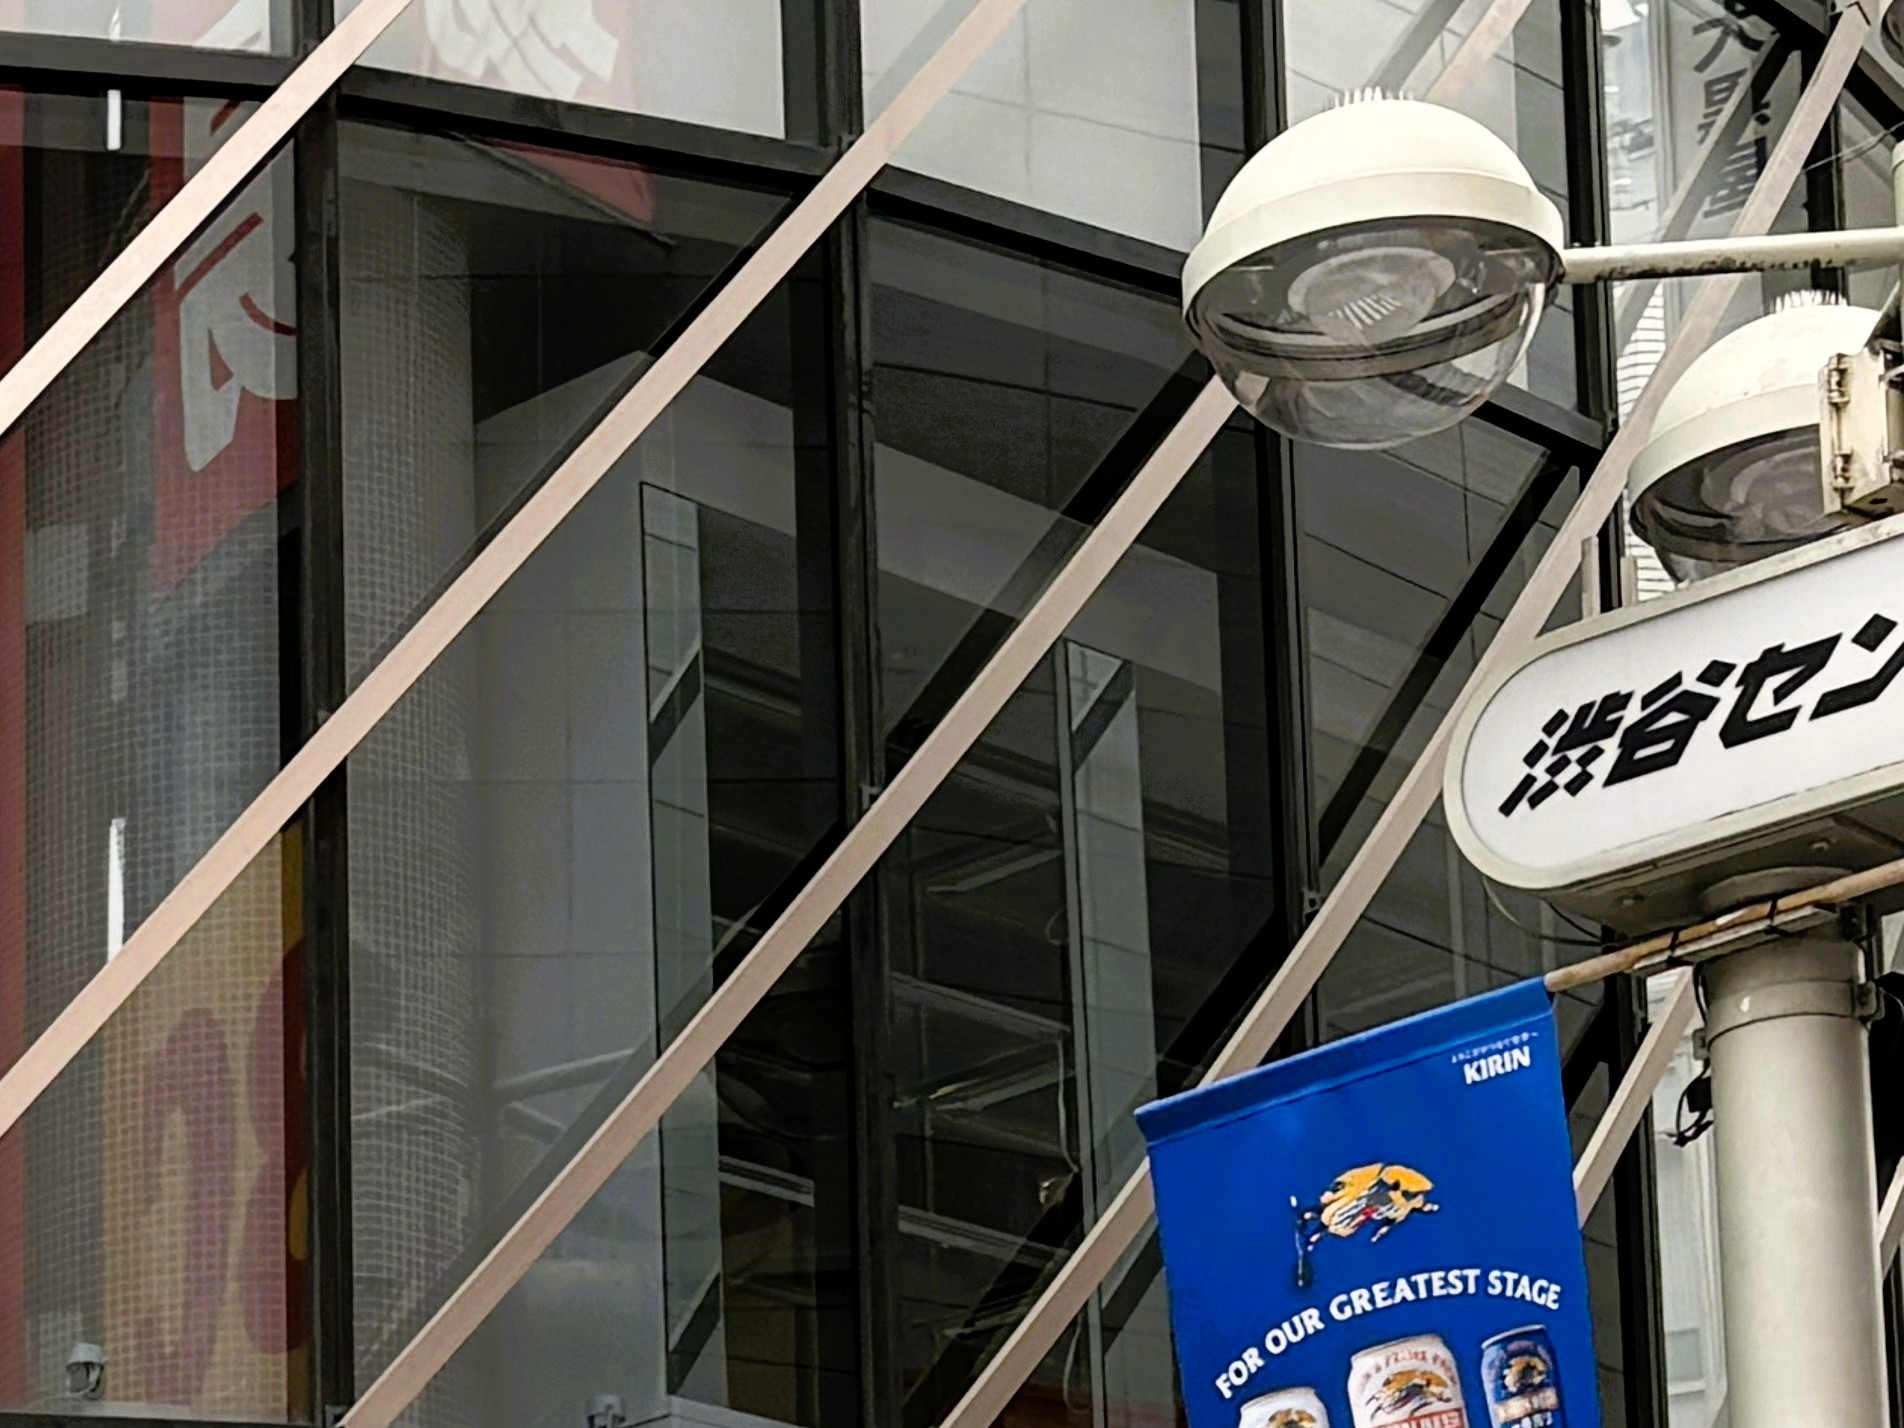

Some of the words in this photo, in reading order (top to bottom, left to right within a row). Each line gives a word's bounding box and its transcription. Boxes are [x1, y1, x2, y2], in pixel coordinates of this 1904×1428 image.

[1498, 611, 1904, 818] 渋谷セン
[1463, 1045, 1531, 1085] KIRIN
[1214, 1345, 1268, 1401] FOR
[1264, 1302, 1326, 1355] OUR
[1328, 1267, 1483, 1332] GREATEST
[1487, 1268, 1563, 1311] STAGE
